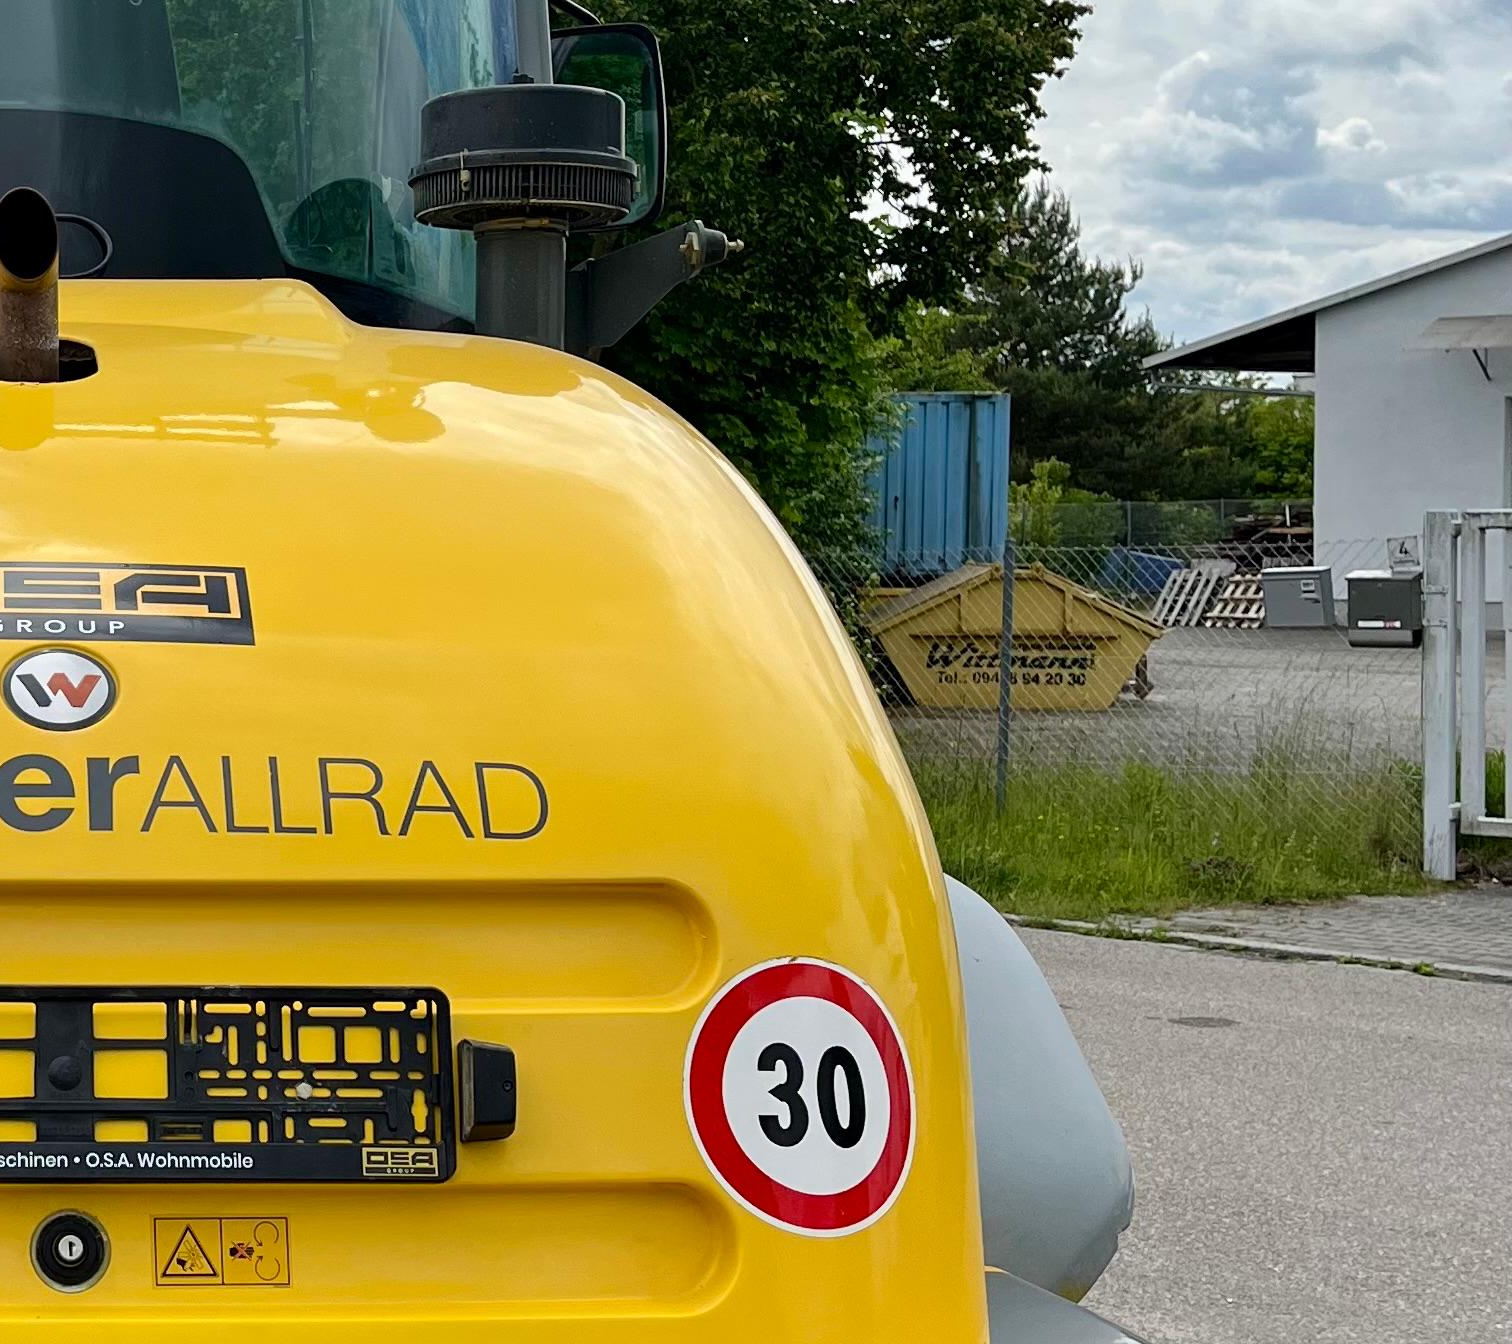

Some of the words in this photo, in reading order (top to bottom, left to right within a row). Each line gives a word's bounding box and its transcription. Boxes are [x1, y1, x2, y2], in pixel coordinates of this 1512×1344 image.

[757, 1042, 866, 1149] 30
[85, 1151, 133, 1168] O.S.A.
[138, 1151, 254, 1169] Wohnmobile
[366, 1151, 434, 1166] OSA
